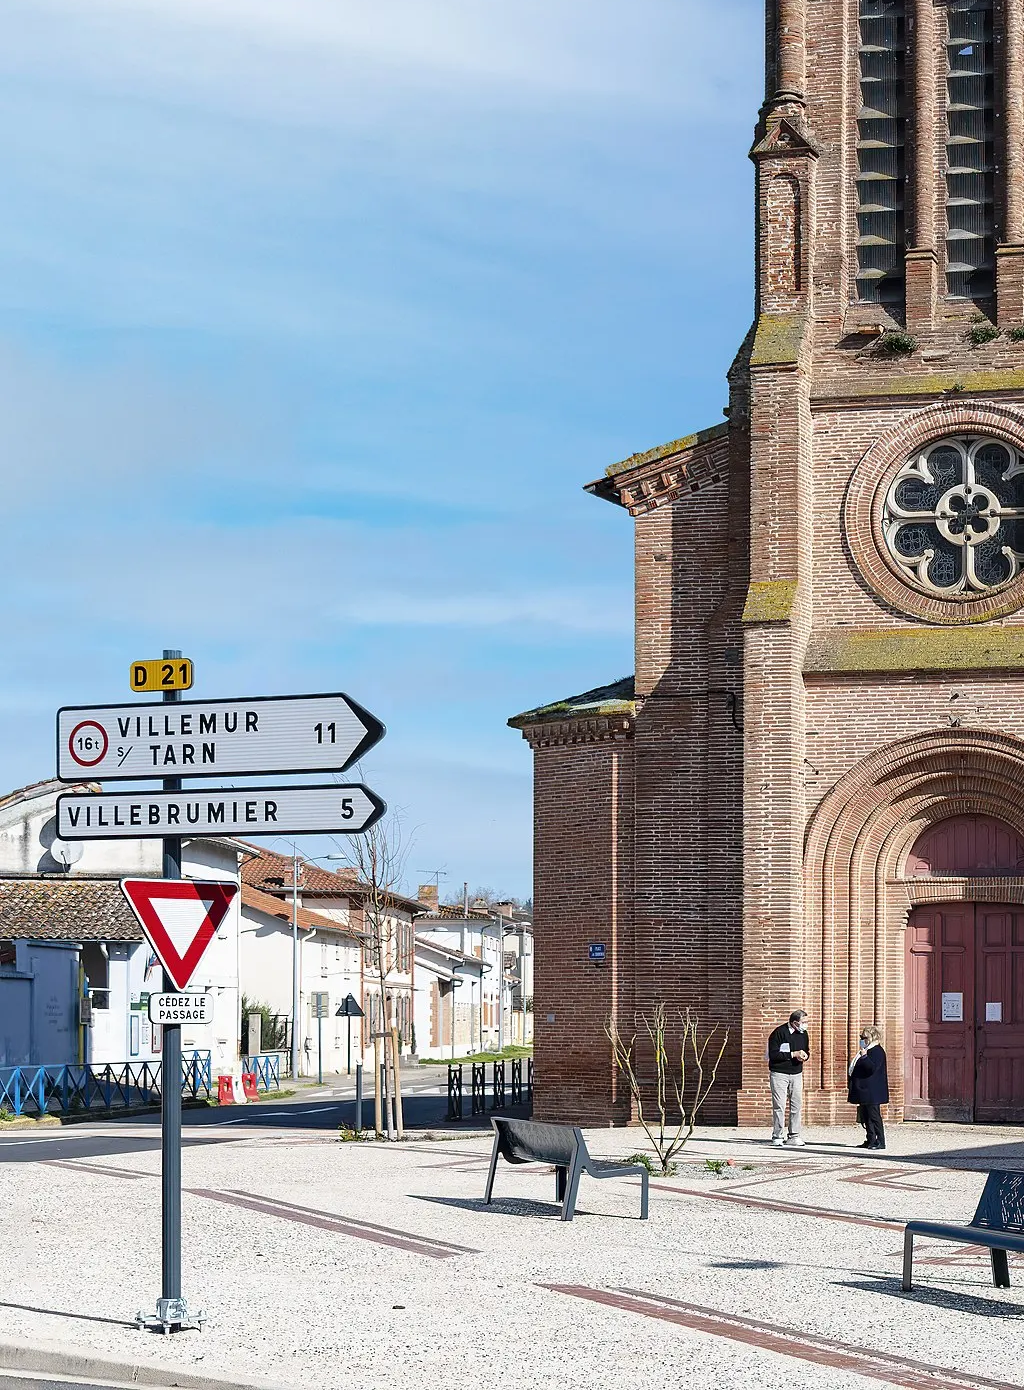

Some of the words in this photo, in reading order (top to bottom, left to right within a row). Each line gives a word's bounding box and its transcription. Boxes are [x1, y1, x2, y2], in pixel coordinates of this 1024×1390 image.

[134, 665, 148, 687] D
[161, 663, 187, 685] 21
[117, 711, 259, 738] VILLEMUR
[314, 722, 336, 744] 11
[149, 742, 216, 766] TARN
[67, 800, 278, 827] VILLEBRUMIER
[340, 798, 355, 820] 5
[158, 995, 191, 1007] CÉDEZ
[194, 997, 206, 1007] LE
[159, 1010, 205, 1020] PASSAGE
